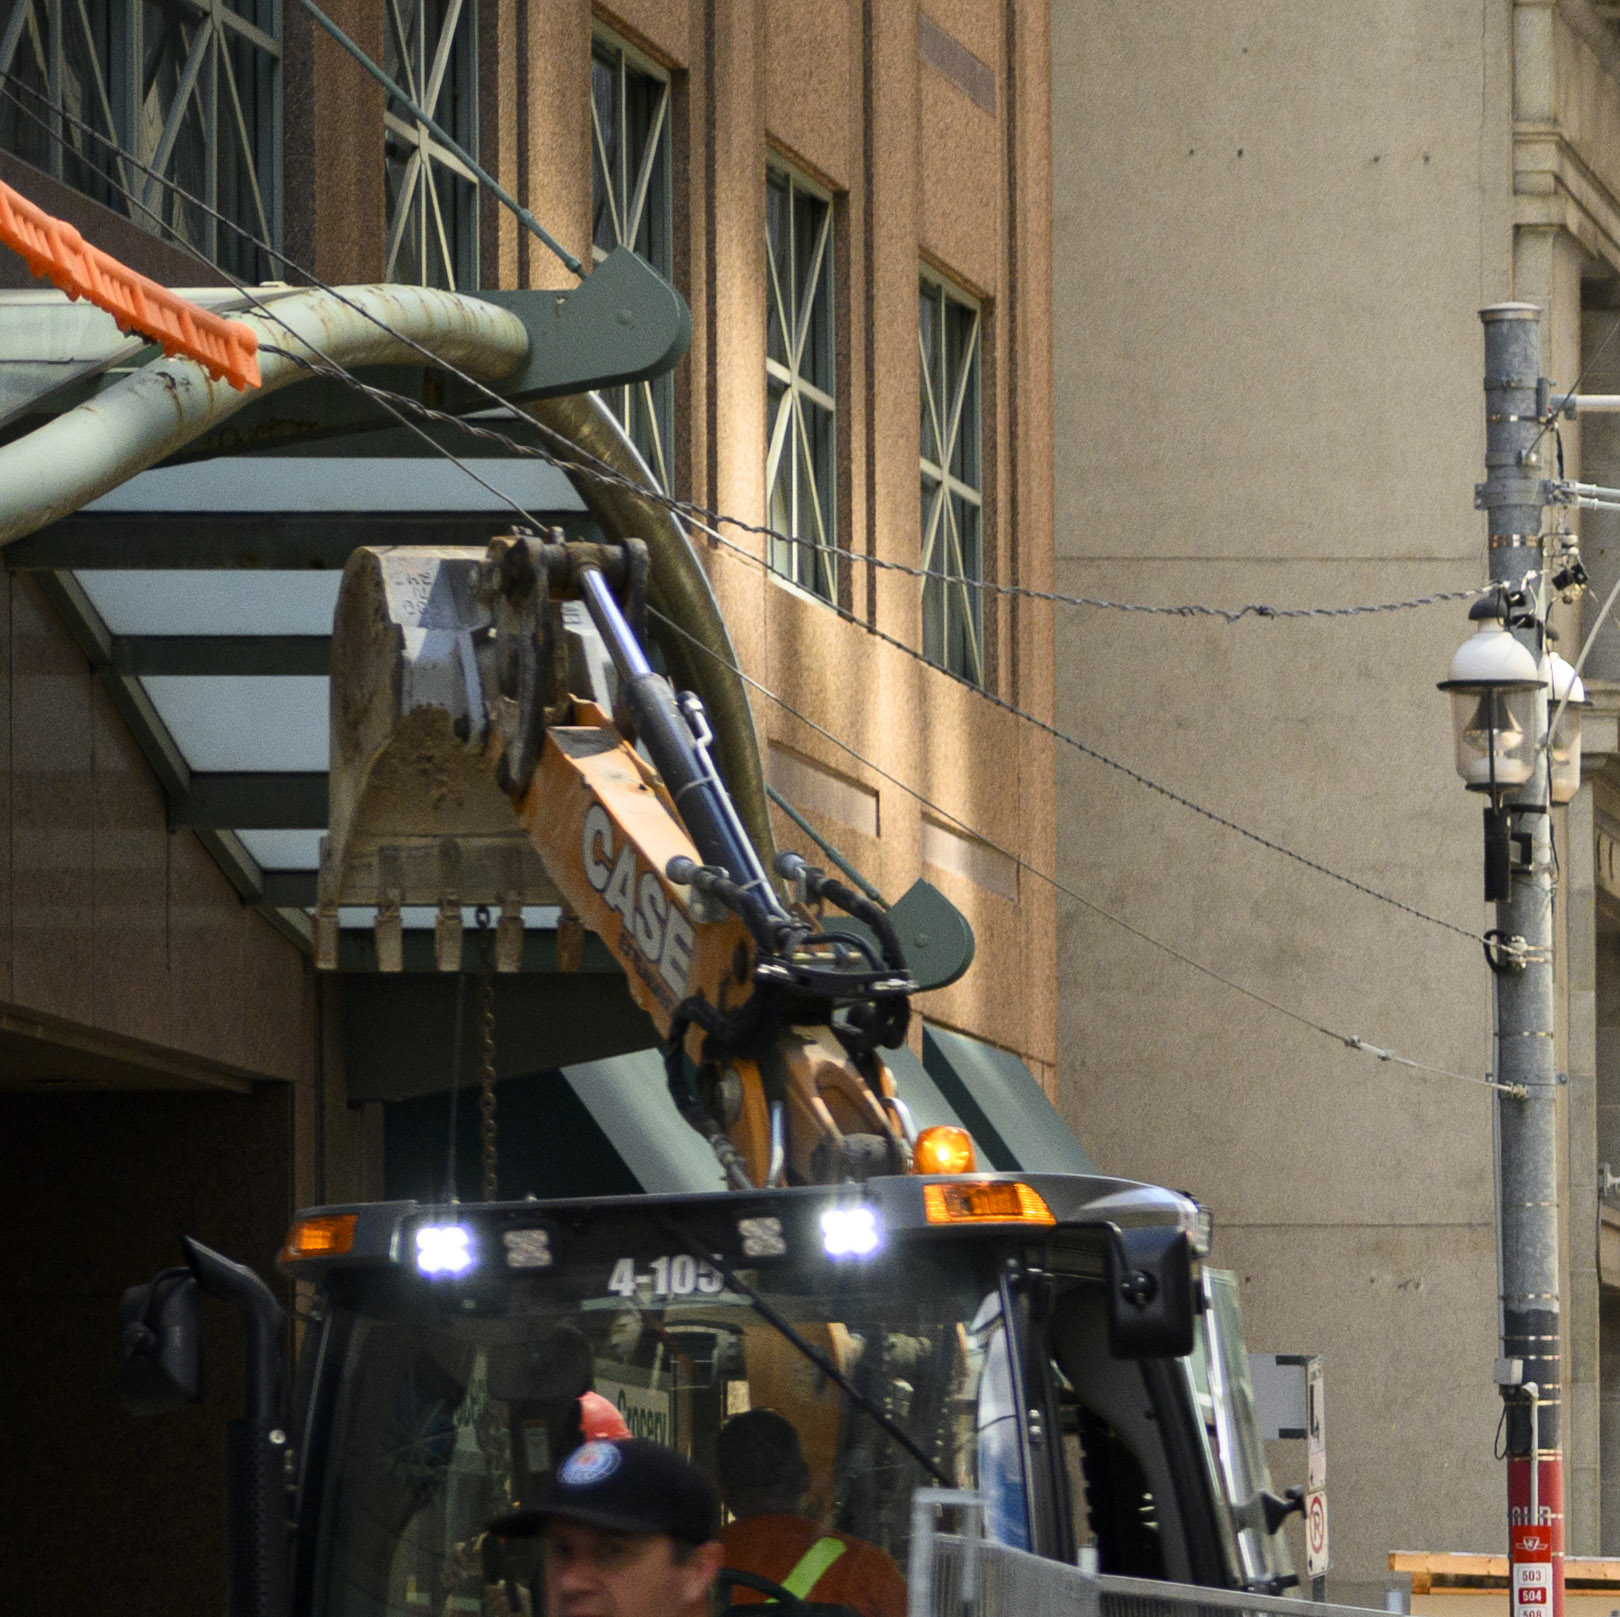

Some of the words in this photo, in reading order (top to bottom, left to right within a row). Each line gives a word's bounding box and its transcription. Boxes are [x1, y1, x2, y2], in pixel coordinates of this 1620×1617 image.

[582, 803, 697, 1001] CASE
[1522, 1570, 1542, 1582] 503
[1522, 1590, 1542, 1602] 504
